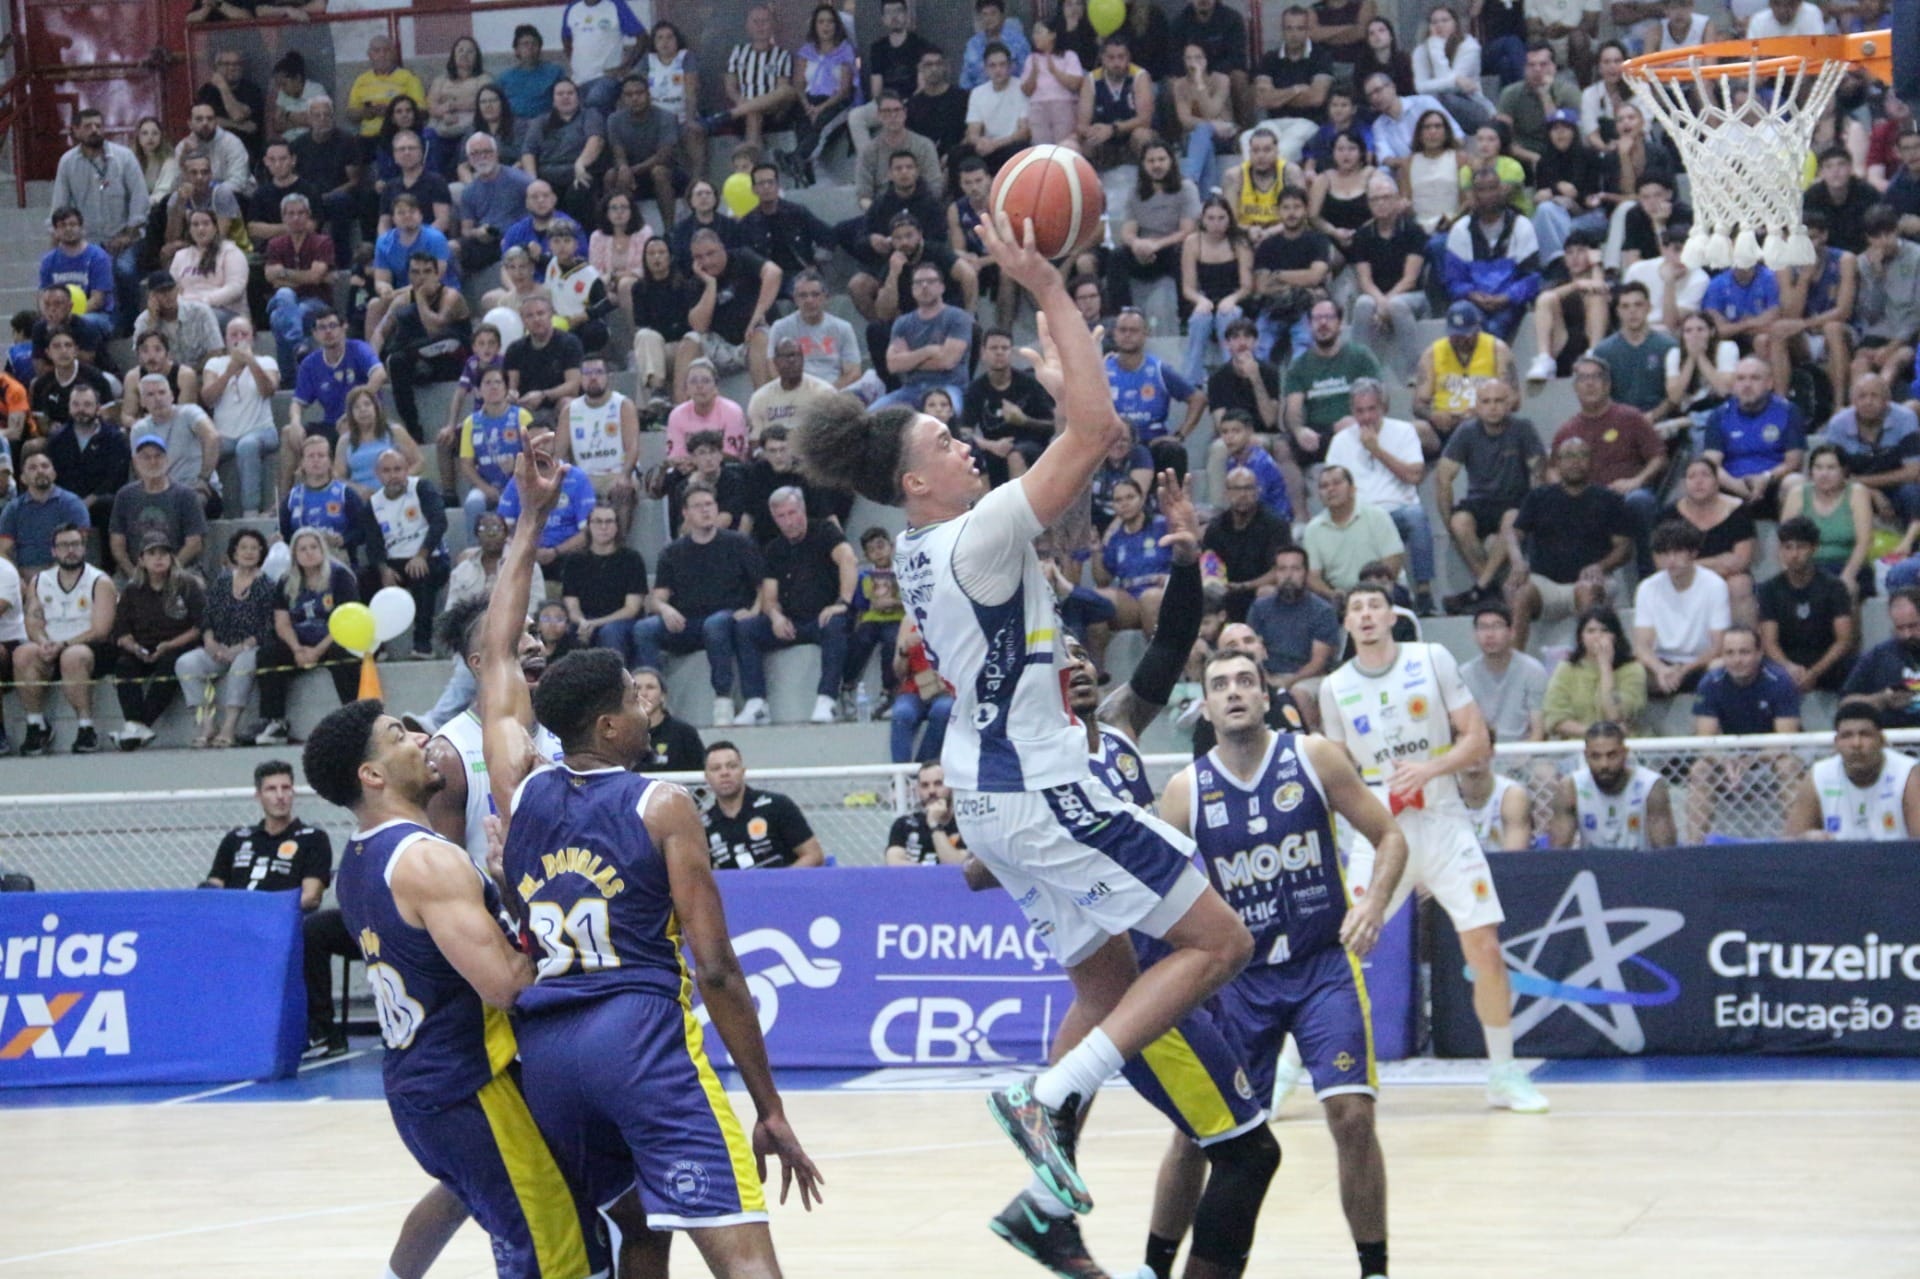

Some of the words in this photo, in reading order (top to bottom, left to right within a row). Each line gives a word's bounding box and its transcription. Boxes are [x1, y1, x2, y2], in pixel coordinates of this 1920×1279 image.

[541, 847, 624, 899] DOUGLAS
[1213, 829, 1322, 892] MOGI
[0, 913, 139, 980] rias
[528, 898, 621, 985] 31
[877, 923, 1056, 971] FORMAÇ
[869, 996, 1022, 1063] CBC
[1715, 993, 1894, 1039] Educação
